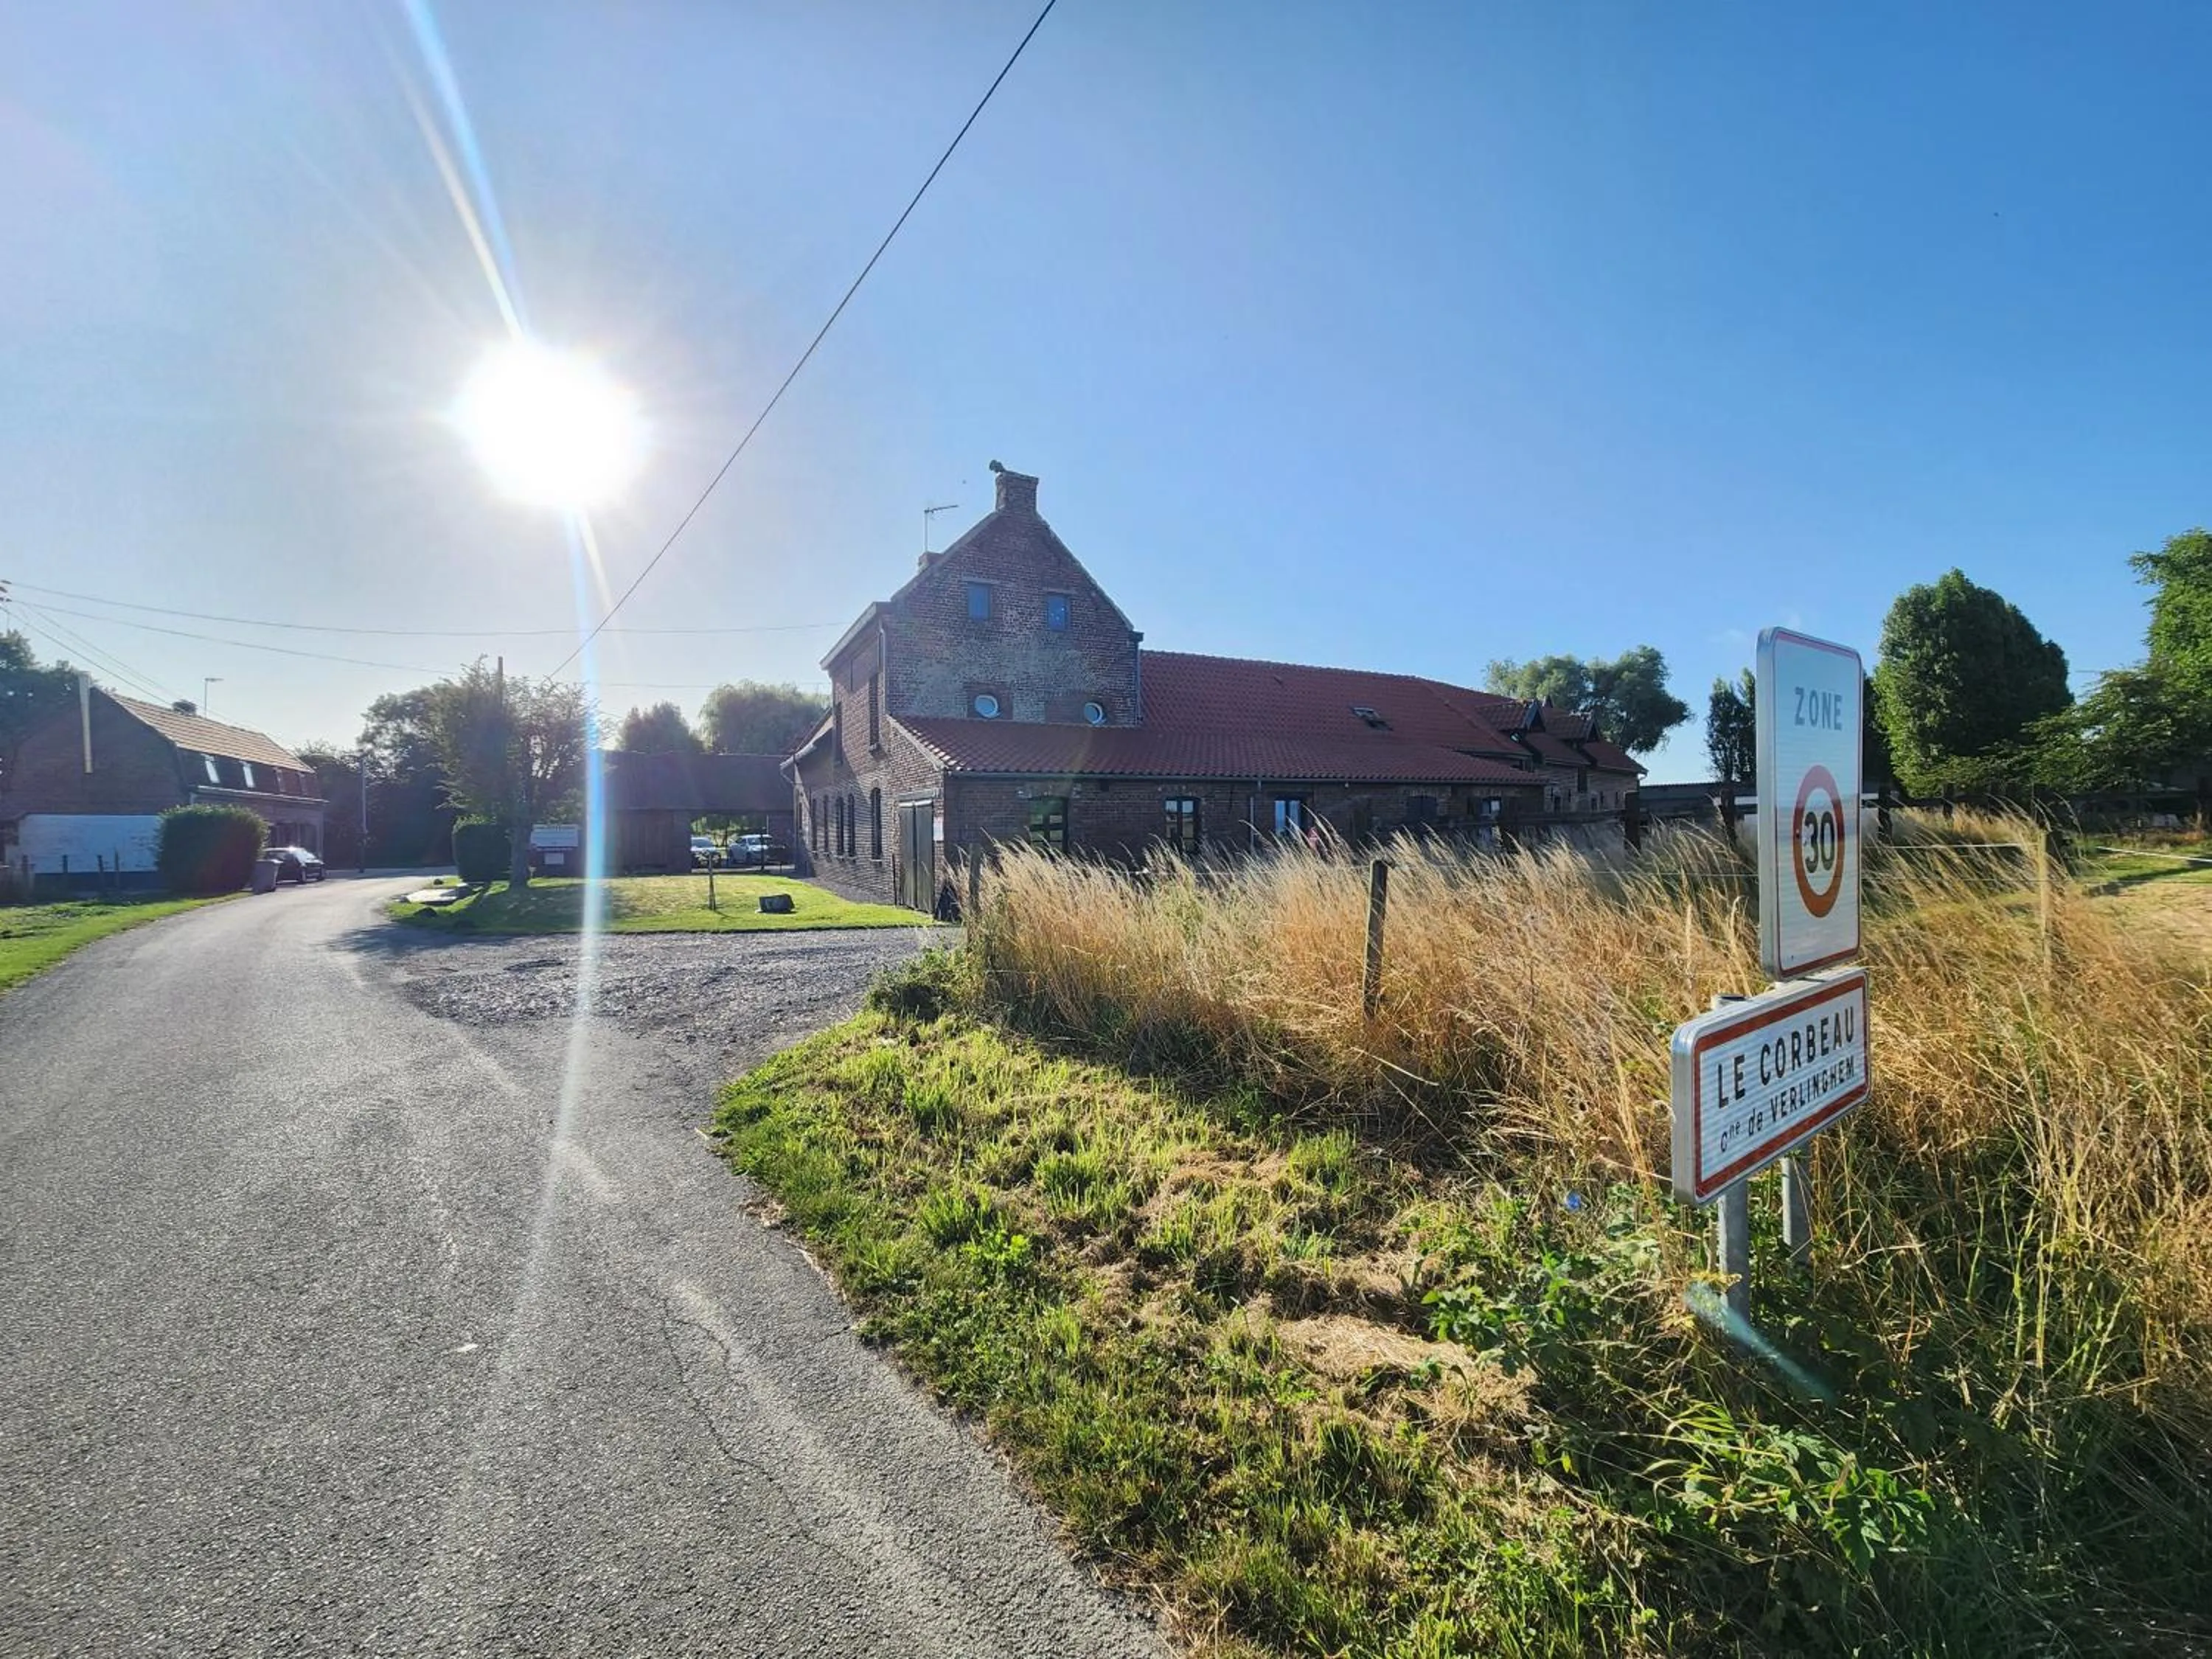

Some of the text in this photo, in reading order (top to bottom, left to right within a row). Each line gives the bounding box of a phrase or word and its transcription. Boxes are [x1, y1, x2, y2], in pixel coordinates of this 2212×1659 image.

[1794, 686, 1842, 731] ZONE
[1804, 811, 1835, 873] 30
[1718, 1006, 1854, 1108] LE CORBEAU
[1748, 1108, 1763, 1137] de
[1770, 1055, 1854, 1122] VERLINGHEM
